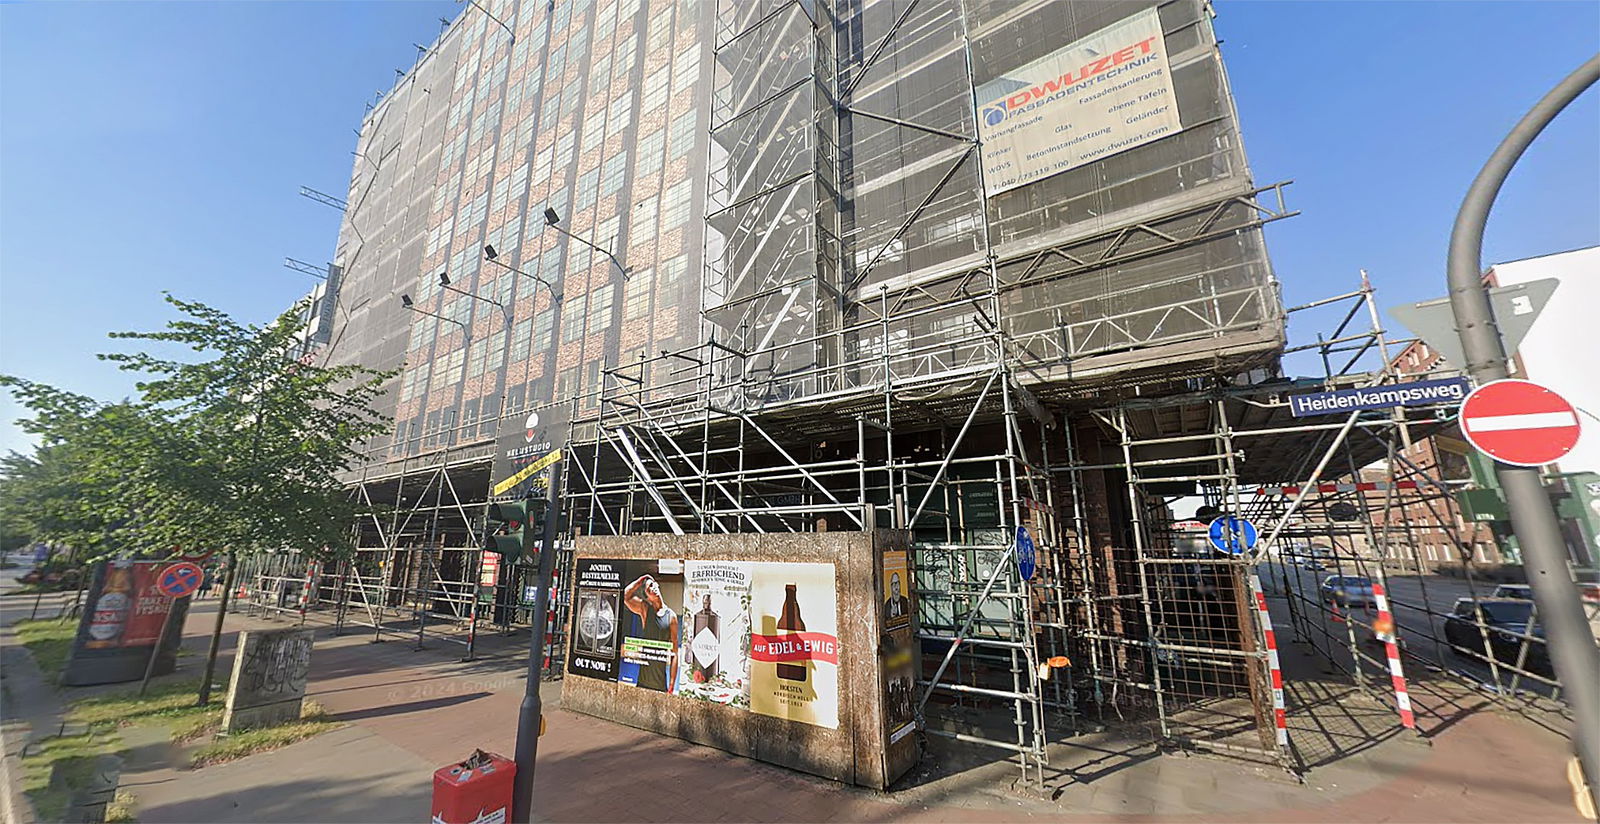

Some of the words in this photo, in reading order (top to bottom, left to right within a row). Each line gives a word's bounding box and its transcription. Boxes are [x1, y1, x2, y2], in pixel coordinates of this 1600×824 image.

[1008, 37, 1156, 109] DWUZET
[1009, 53, 1158, 118] FASSADENTECHNIK
[1079, 67, 1162, 105] Fassadensanierung
[1108, 98, 1136, 114] ebene
[1137, 87, 1167, 103] Tafeln
[1055, 122, 1073, 134] Glas
[1126, 104, 1169, 125] Geländer
[1079, 125, 1169, 160] www.dwuzet.com
[1298, 383, 1464, 412] Heidenkampsweg
[692, 569, 745, 581] ERFRISCHEND
[753, 644, 766, 653] AUF
[768, 640, 796, 655] EDEL
[796, 643, 802, 651] &
[804, 639, 834, 655] EWIG
[575, 657, 591, 669] OUT
[590, 660, 606, 672] NOW
